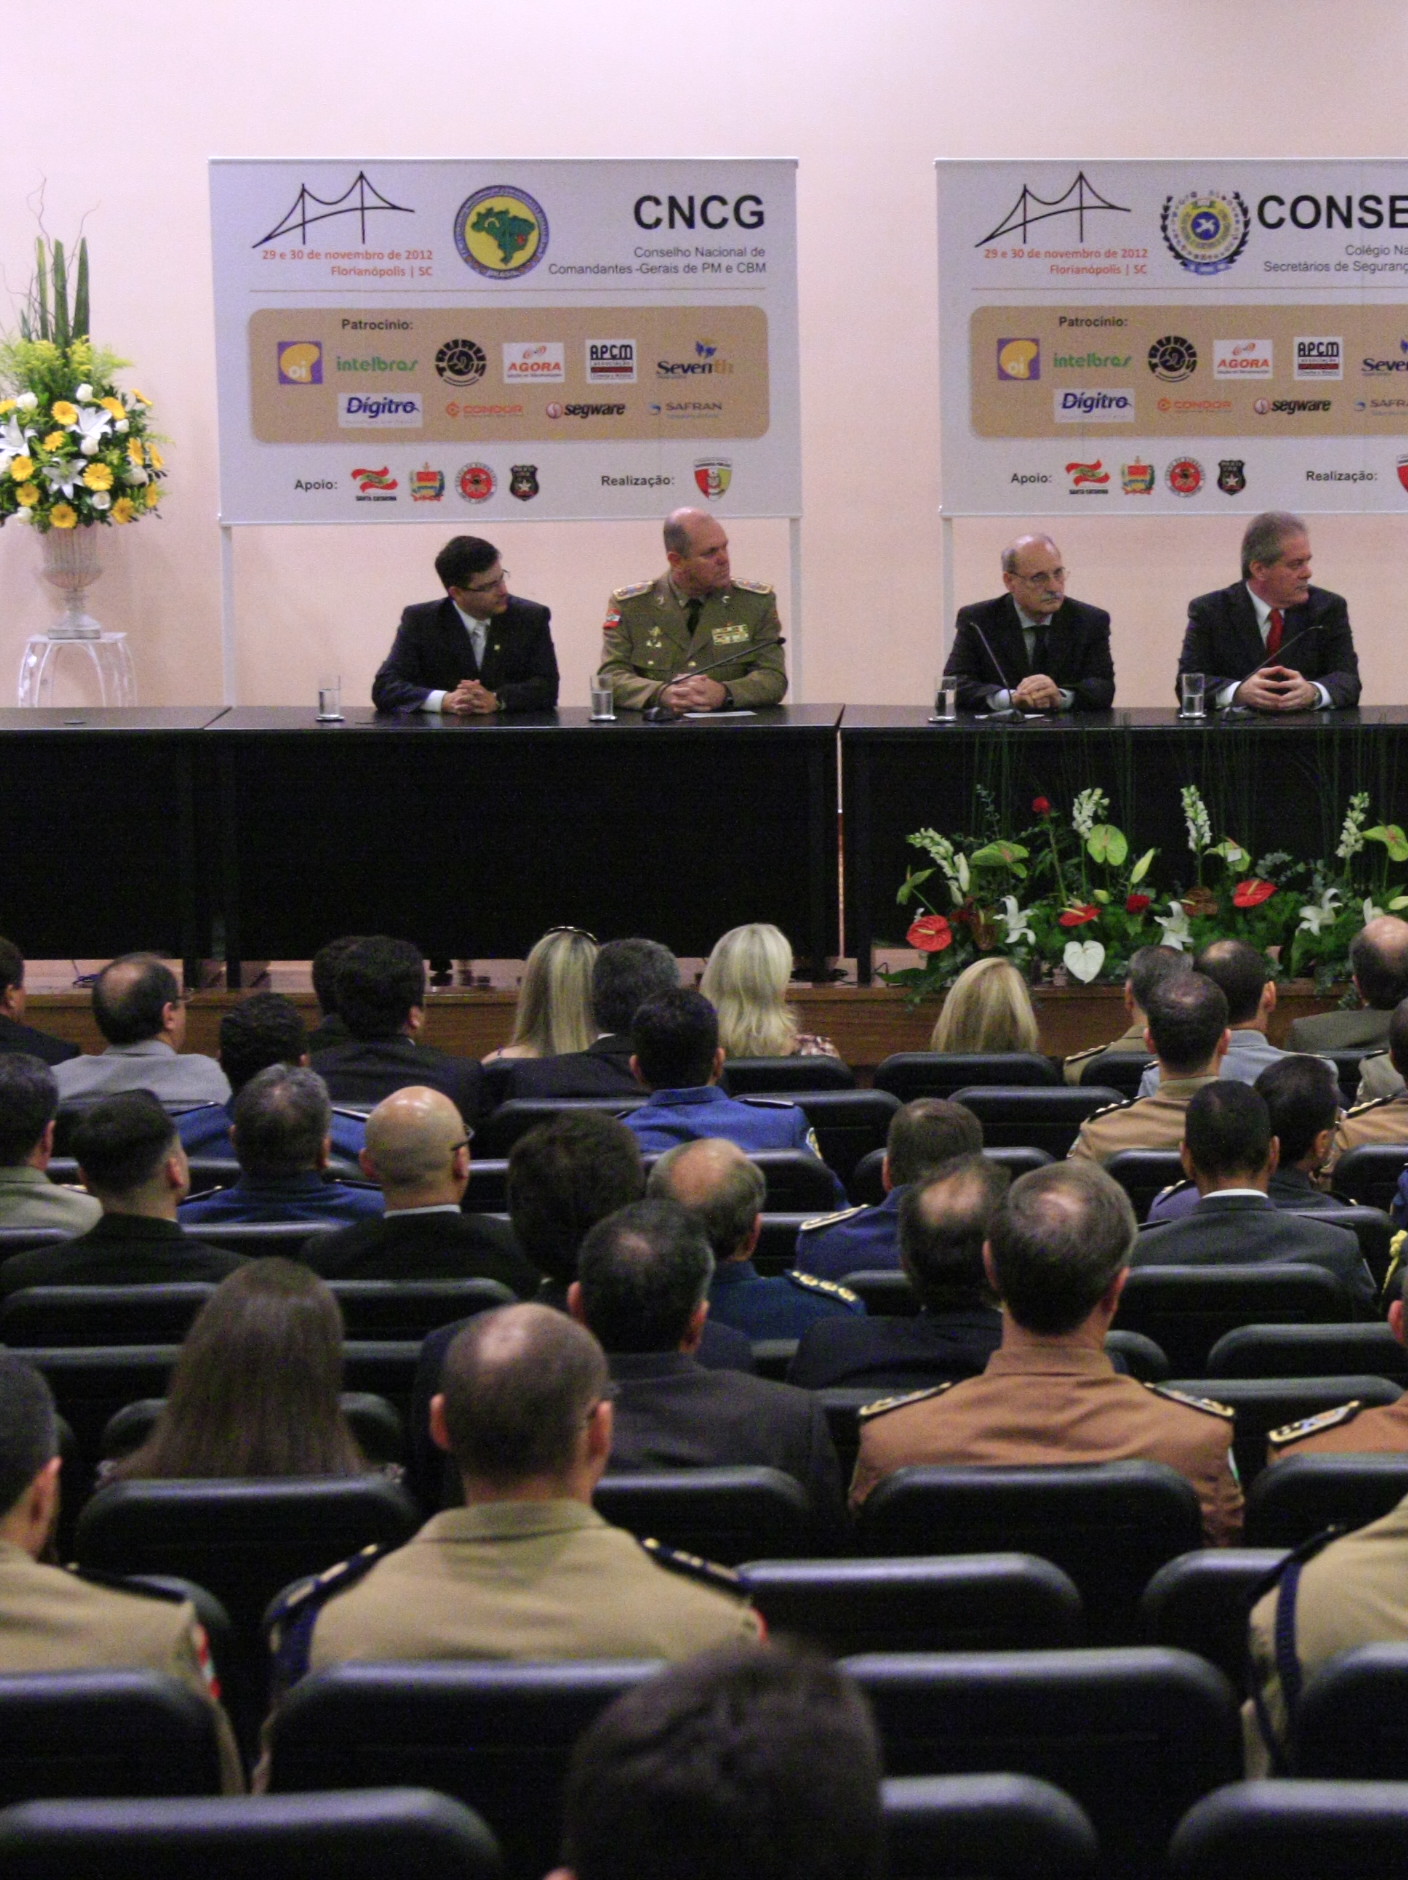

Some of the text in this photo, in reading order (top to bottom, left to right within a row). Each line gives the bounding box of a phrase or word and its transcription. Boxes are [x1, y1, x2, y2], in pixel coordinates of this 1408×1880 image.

[633, 194, 765, 230] CNCG
[262, 249, 433, 260] 29 e 30 de novembro de 2012
[634, 246, 765, 258] Conselho Nacional de
[984, 248, 1148, 259] 29 e 30 de novembro de 2012
[1345, 245, 1391, 258] Colégio
[331, 266, 405, 278] Florianópolis
[419, 266, 433, 276] SC
[549, 264, 632, 275] Comandantes
[683, 263, 698, 274] de
[702, 263, 722, 273] PM
[726, 265, 733, 273] e
[736, 262, 767, 273] CBM
[1050, 264, 1121, 276] Florianópolis
[1134, 264, 1147, 274] SC
[1263, 260, 1331, 272] Secretários
[1334, 260, 1349, 271] de
[590, 344, 633, 360] APCM
[1298, 341, 1339, 357] APCM
[336, 357, 419, 372] intelbras
[1007, 356, 1026, 374] oi
[1053, 352, 1133, 368] intelbras
[1217, 358, 1270, 369] AGORA
[288, 361, 306, 378] oi
[508, 362, 562, 372] AGORA
[656, 360, 734, 375] Seventh
[564, 402, 625, 419] segware
[665, 402, 722, 411] SAFRAN
[1271, 399, 1332, 415] segware
[601, 474, 675, 488] Realização:
[1011, 473, 1052, 486] Apoio:
[1306, 470, 1378, 484] Realização:
[294, 479, 338, 492] Apoio:
